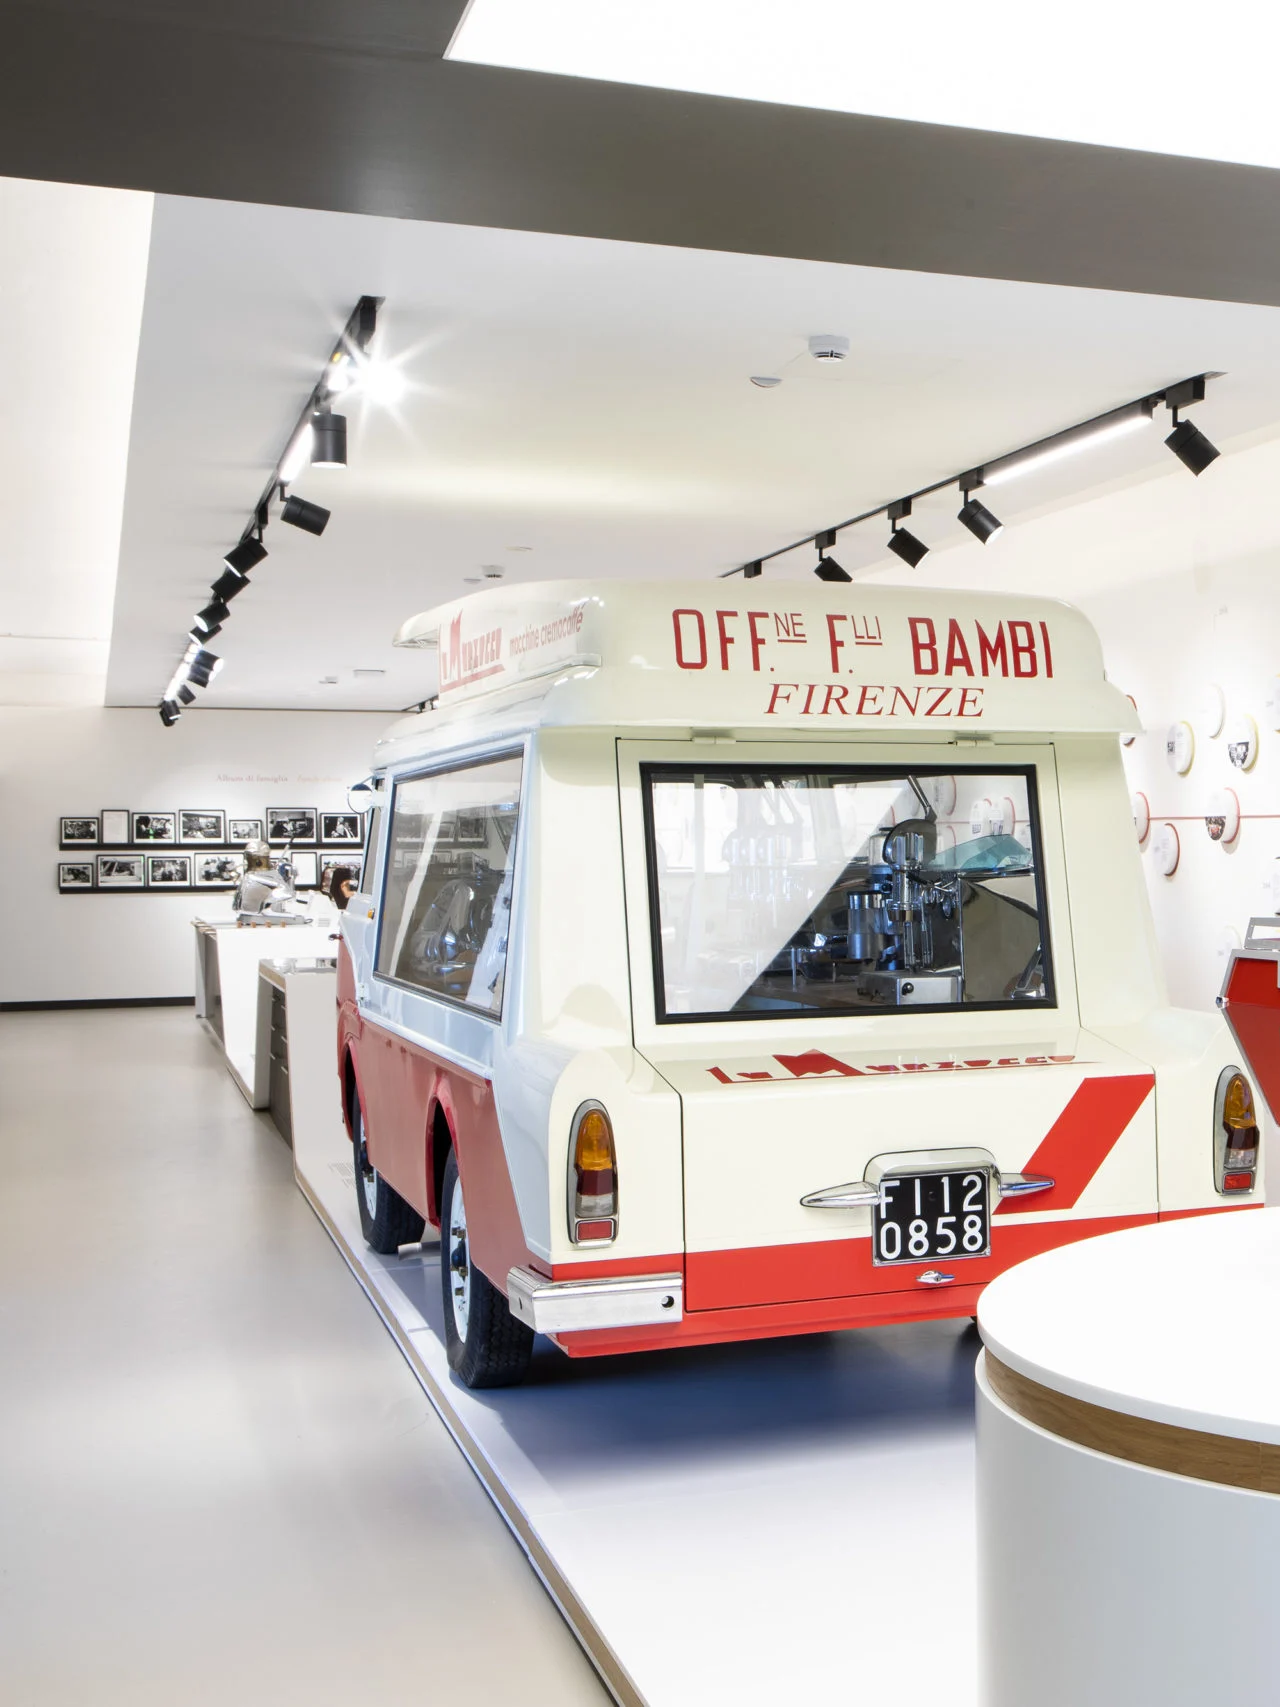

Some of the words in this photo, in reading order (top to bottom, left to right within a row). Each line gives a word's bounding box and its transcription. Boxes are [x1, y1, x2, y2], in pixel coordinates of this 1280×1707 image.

[908, 616, 1054, 679] BAMBI
[764, 682, 985, 717] FIRENZE
[879, 1215, 984, 1261] 0858
